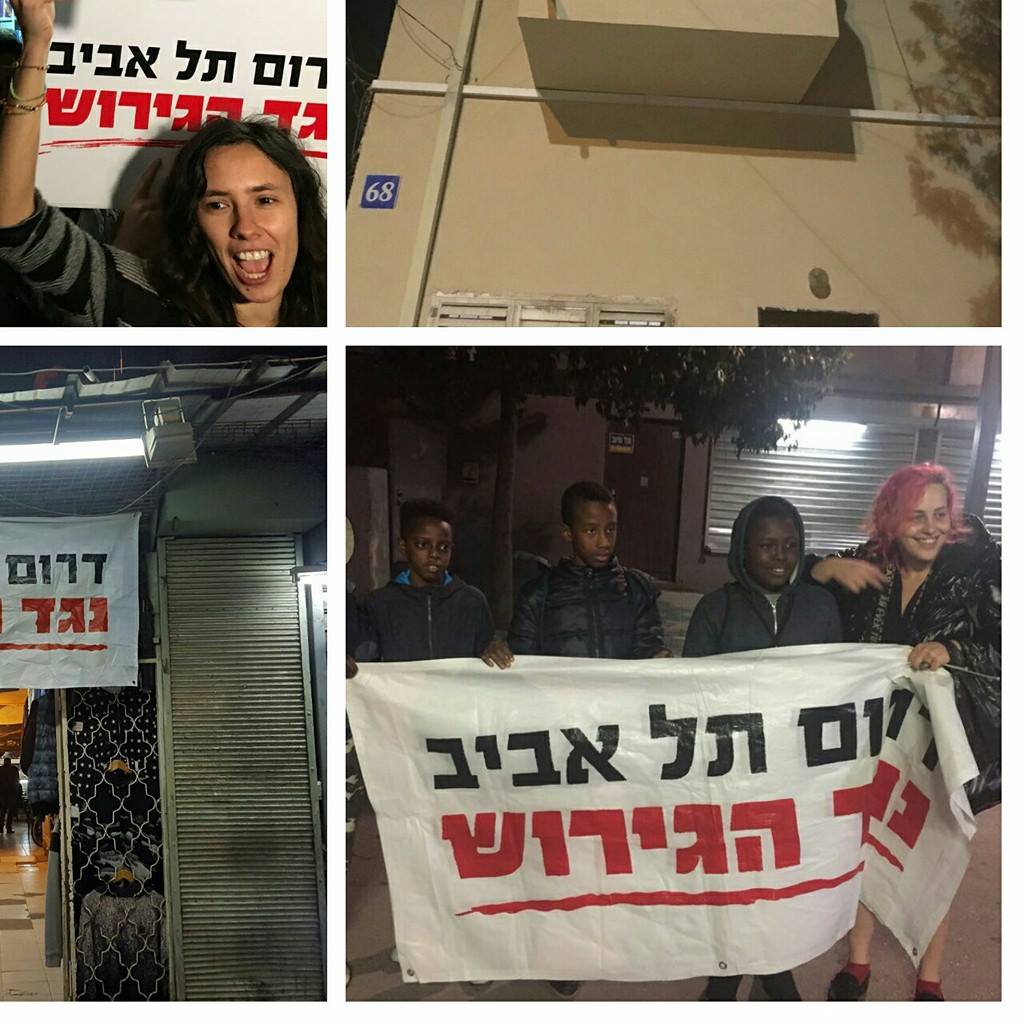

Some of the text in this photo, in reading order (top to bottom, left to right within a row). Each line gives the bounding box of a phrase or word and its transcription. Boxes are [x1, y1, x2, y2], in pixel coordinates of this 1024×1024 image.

[46, 40, 327, 89] רום תל אביב
[366, 182, 395, 202] 68
[6, 554, 107, 584] דרום
[21, 598, 108, 633] נגד
[425, 725, 626, 789] אביב
[649, 704, 767, 780] תל
[441, 799, 800, 878] הגירוש
